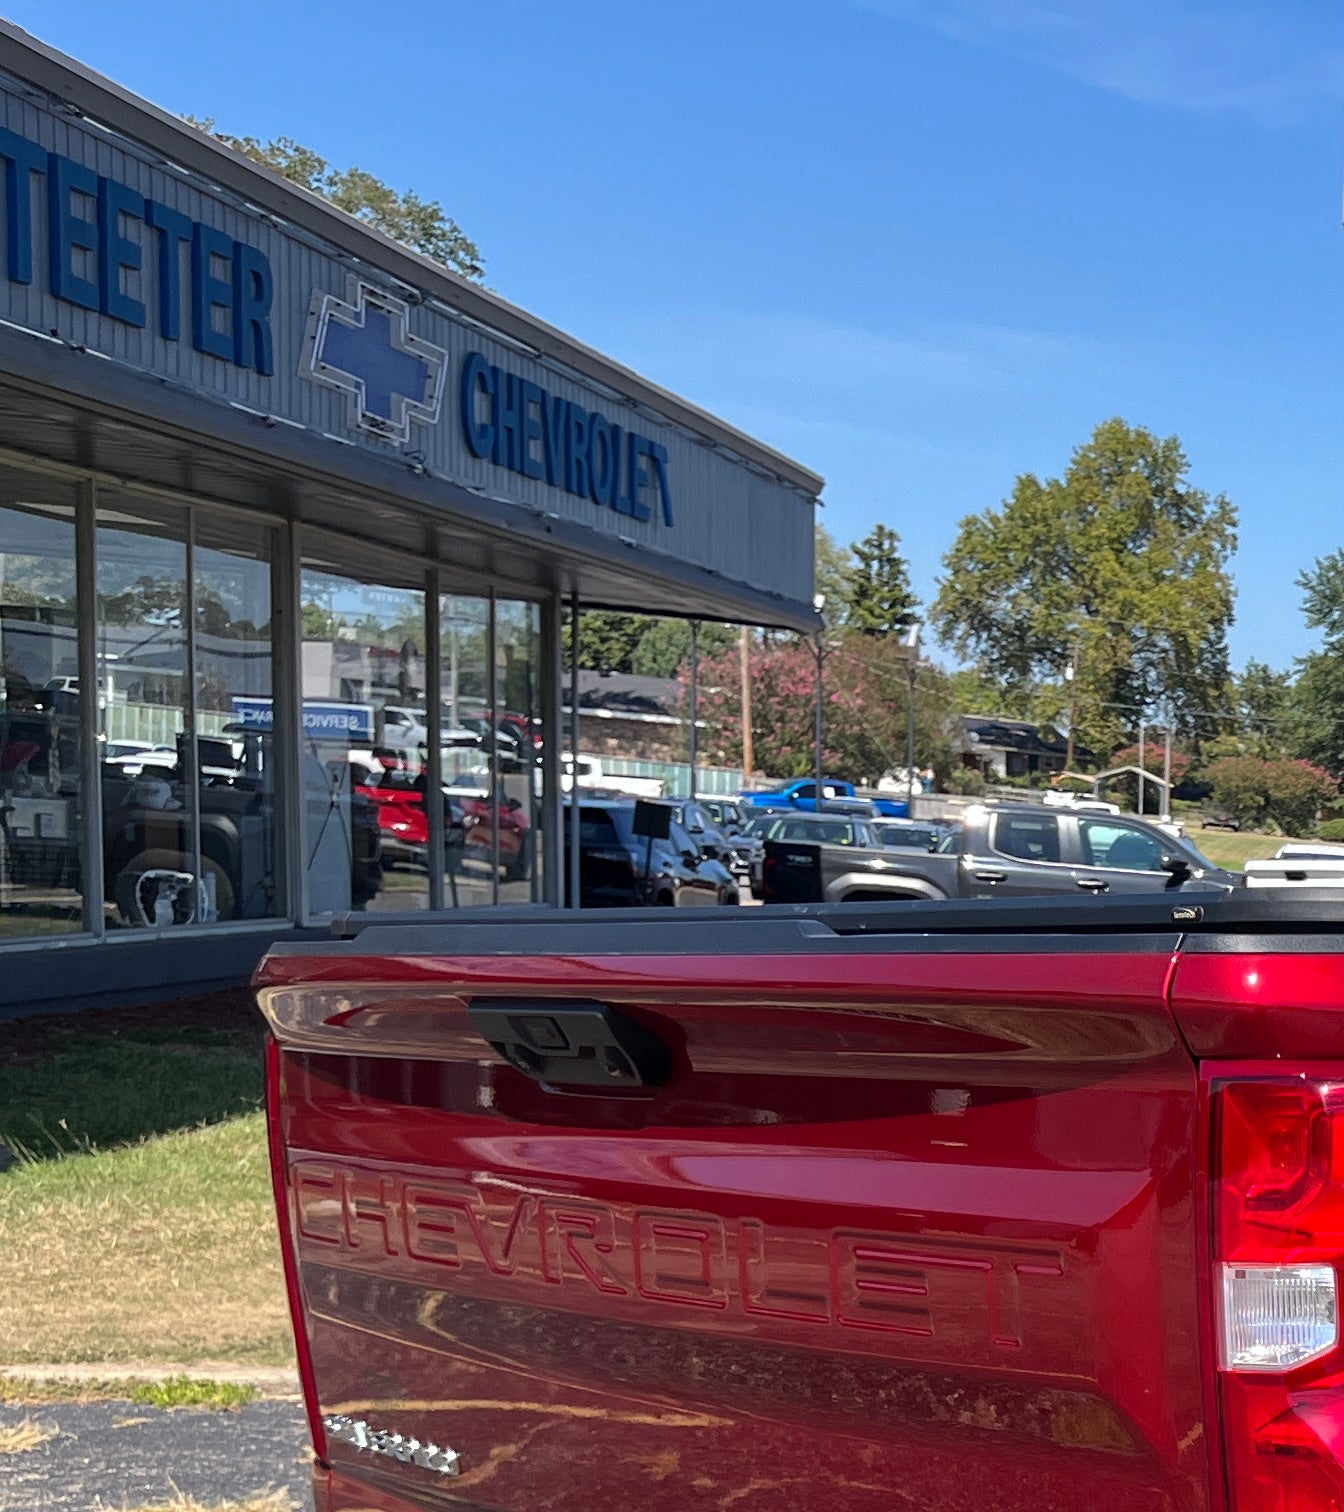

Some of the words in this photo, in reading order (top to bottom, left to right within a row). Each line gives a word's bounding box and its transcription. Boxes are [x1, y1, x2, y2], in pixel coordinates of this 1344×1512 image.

[0, 126, 274, 377] TEETER
[461, 351, 674, 528] CHEVROLET
[293, 1163, 1065, 1347] CHEVROLET
